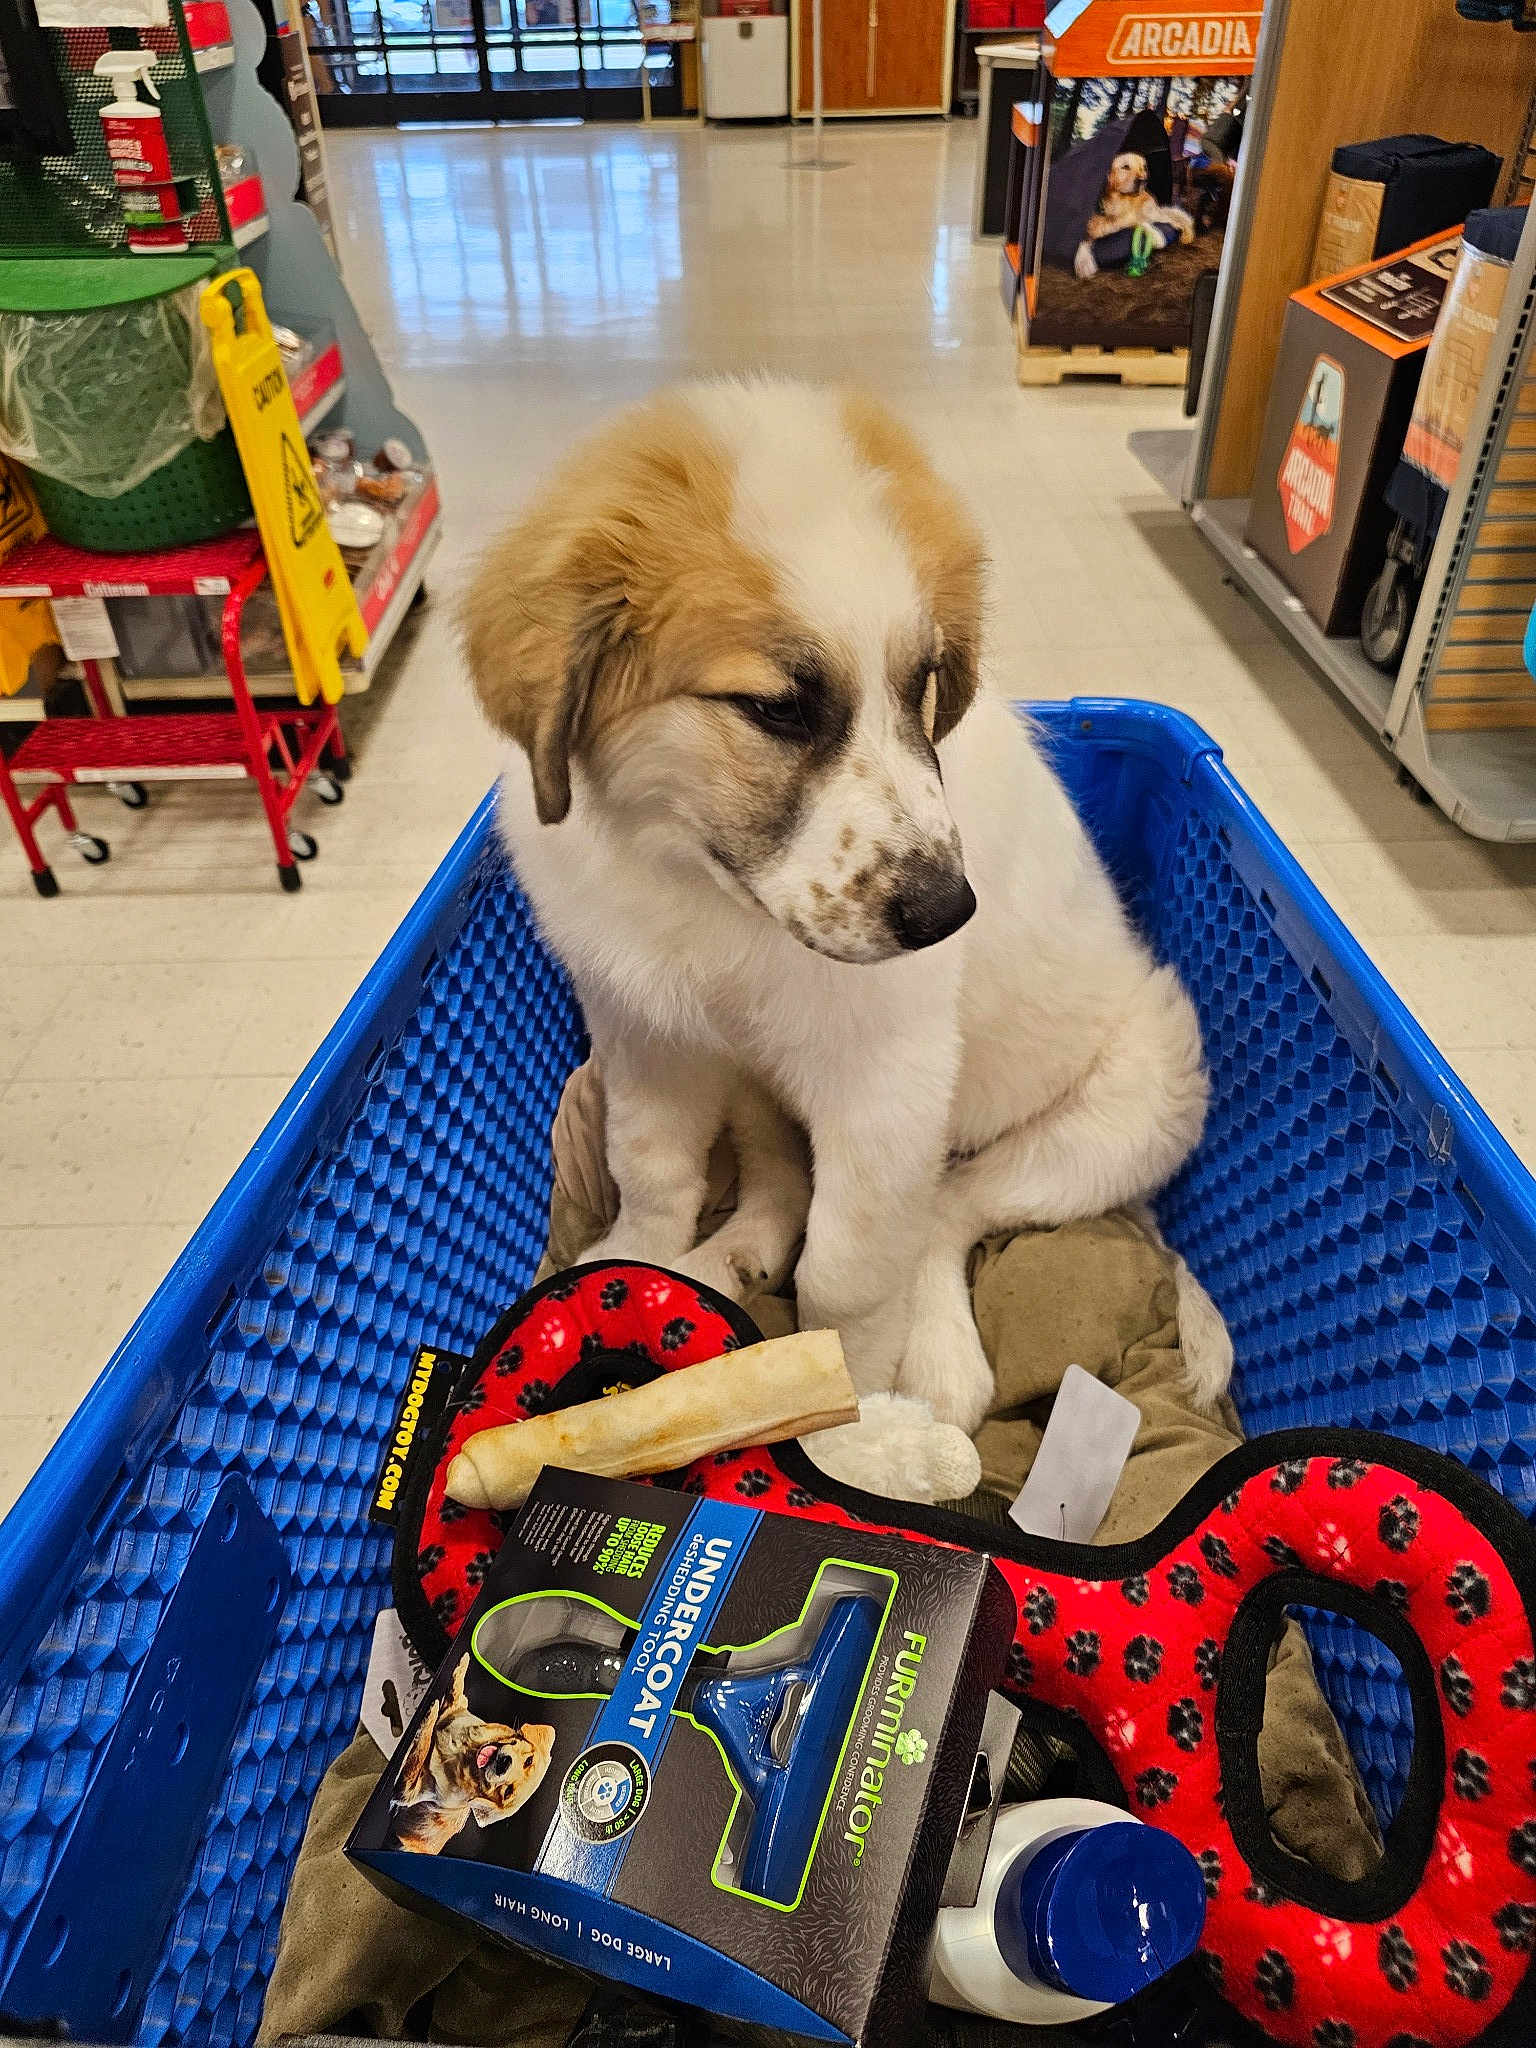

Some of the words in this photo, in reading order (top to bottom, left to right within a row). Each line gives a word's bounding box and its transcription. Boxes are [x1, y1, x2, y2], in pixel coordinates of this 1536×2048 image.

[1119, 20, 1253, 57] ARCADIA
[376, 1351, 437, 1511] MYDOGTOY.COM
[606, 1532, 624, 1547] TO
[615, 1517, 631, 1533] UP
[628, 1521, 651, 1551] LOOSE
[605, 1539, 630, 1573] SHEDDING
[614, 1550, 636, 1575] HAIR
[627, 1523, 666, 1579] REDUCES
[653, 1533, 705, 1627] deSHEDDING
[628, 1538, 734, 1739] UNDERCOAT
[630, 1631, 662, 1680] TOOL
[871, 1655, 891, 1697] PROVIDES
[854, 1697, 878, 1752] GROOMING
[571, 1760, 589, 1782] LONG
[629, 1759, 644, 1788] LARGE
[836, 1749, 861, 1813] CONFIDENCE
[631, 1788, 644, 1808] DOG
[494, 1893, 527, 1915] HAIR
[530, 1906, 570, 1932] LONG
[591, 1928, 622, 1951] DOG
[626, 1941, 672, 1972] LARGE
